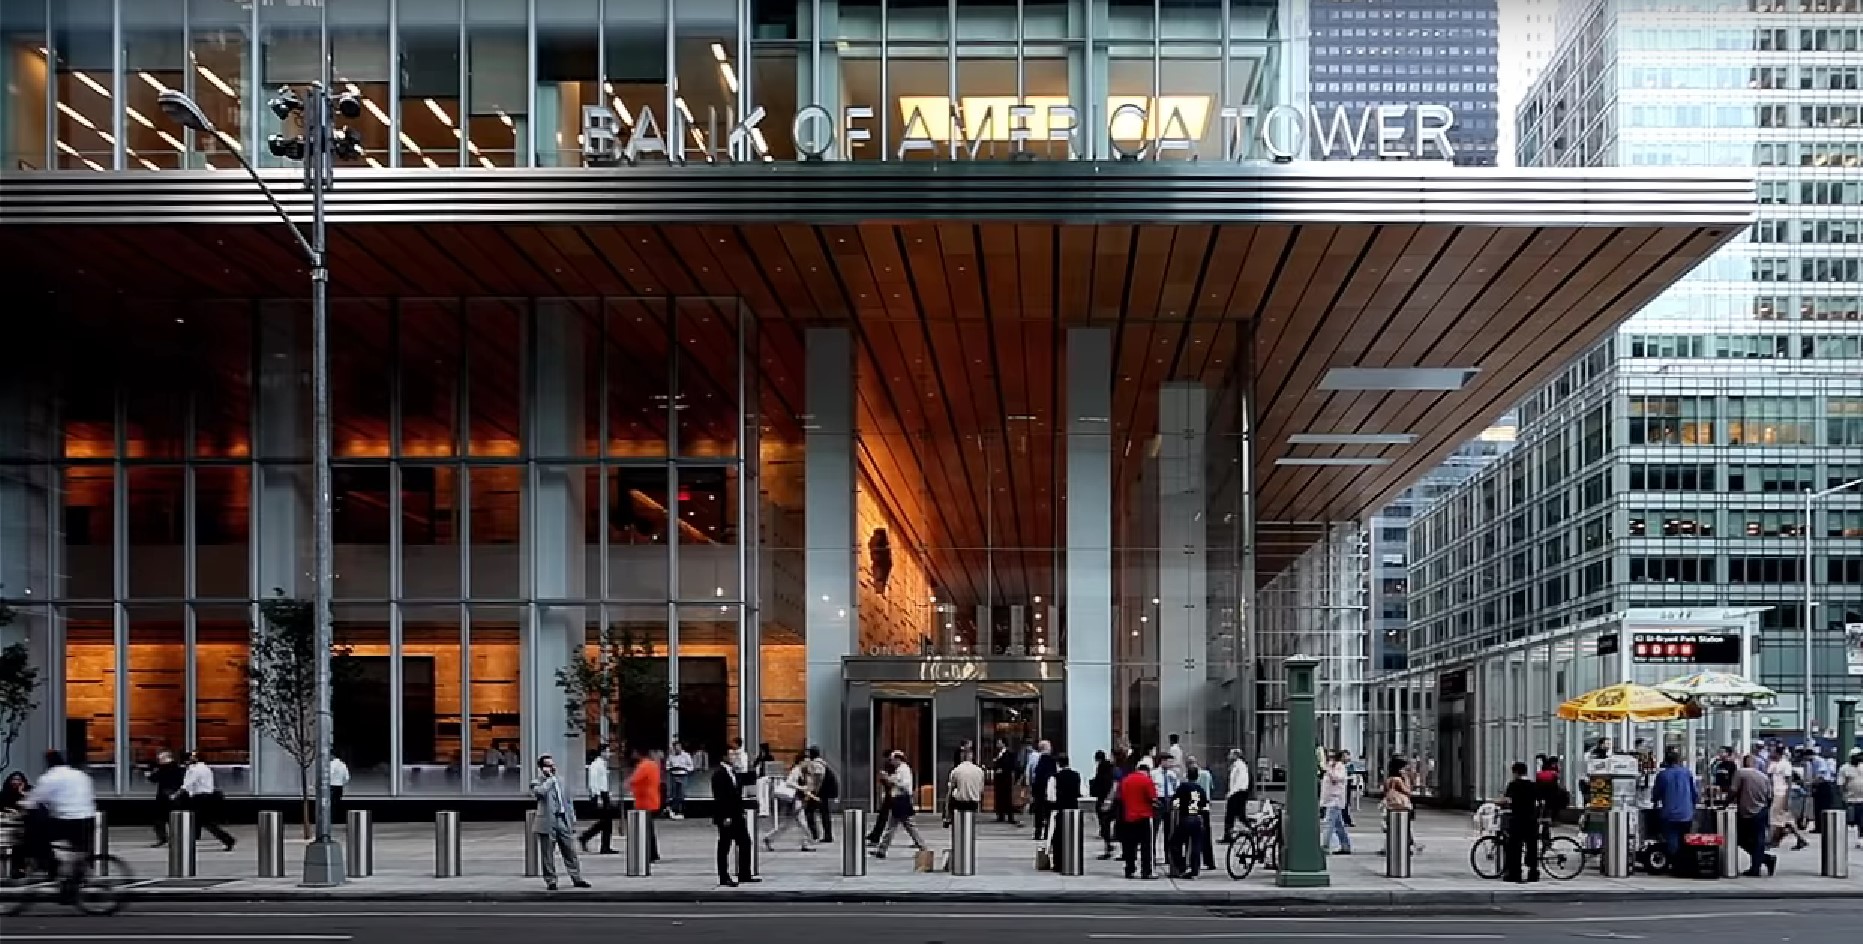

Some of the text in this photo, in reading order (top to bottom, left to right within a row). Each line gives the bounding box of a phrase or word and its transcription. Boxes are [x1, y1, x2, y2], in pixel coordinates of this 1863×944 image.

[582, 104, 1456, 161] BANK OF AMERICA TOWER
